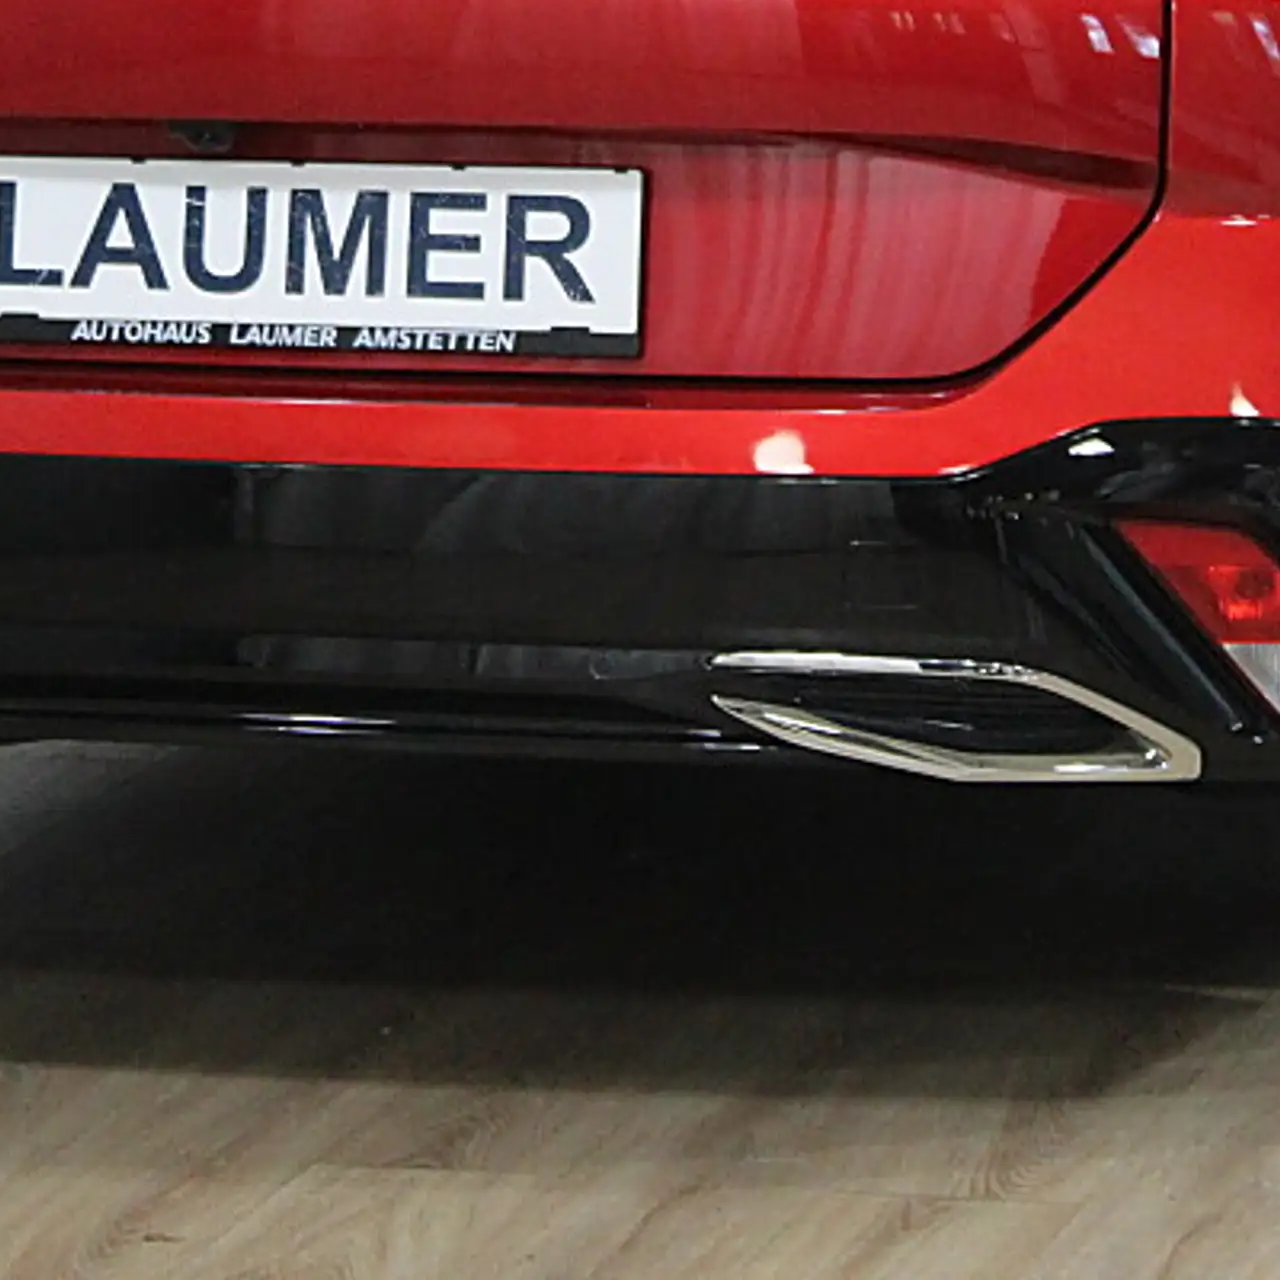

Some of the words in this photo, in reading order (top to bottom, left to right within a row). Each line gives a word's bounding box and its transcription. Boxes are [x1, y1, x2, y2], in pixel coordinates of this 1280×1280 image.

[70, 320, 211, 345] AUTOHAUS
[229, 324, 337, 349] LAUMER
[353, 328, 517, 354] AMSTETTEN
